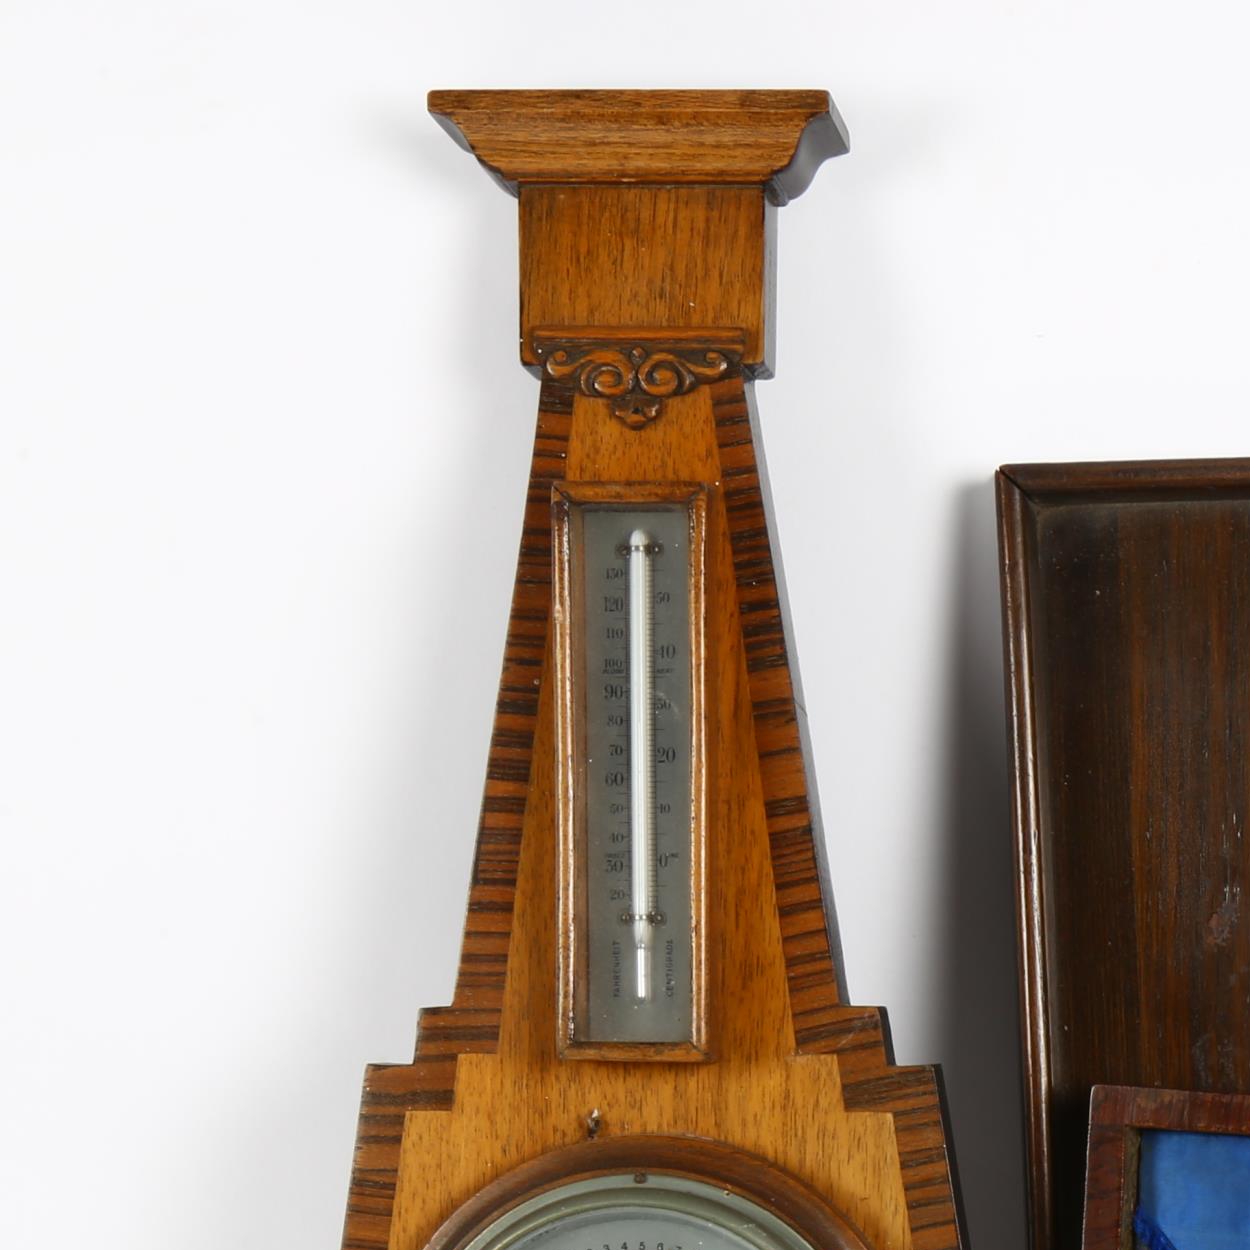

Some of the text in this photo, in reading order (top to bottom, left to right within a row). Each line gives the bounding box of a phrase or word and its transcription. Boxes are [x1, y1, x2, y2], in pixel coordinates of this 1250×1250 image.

[604, 597, 623, 612] 120
[606, 628, 623, 639] 110
[604, 684, 623, 699] 90
[607, 715, 623, 727] 80
[609, 744, 623, 756] 70
[657, 747, 676, 763] 20
[605, 772, 624, 786] 60
[609, 890, 624, 900] 20
[621, 1242, 628, 1250] 4
[639, 1242, 646, 1250] 5
[657, 1242, 664, 1250] 6
